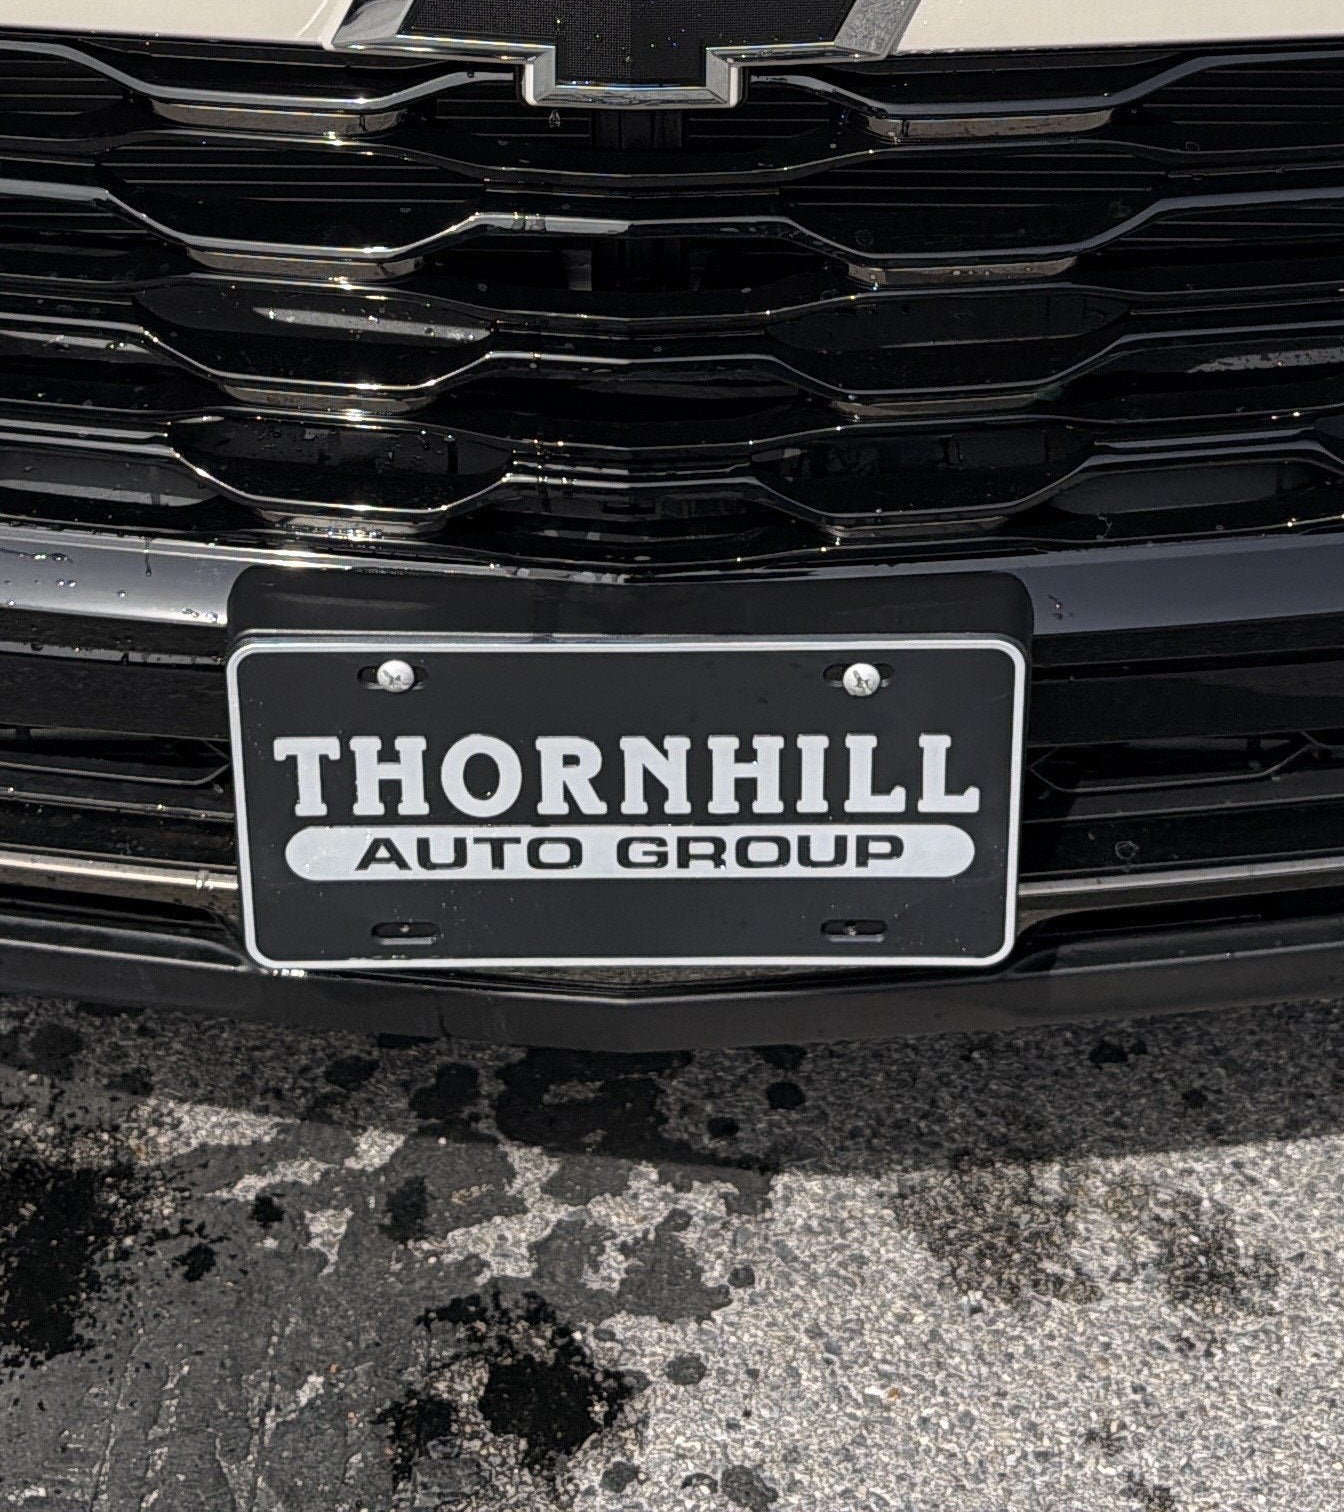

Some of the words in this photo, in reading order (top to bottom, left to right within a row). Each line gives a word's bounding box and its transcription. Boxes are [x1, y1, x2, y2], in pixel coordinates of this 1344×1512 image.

[272, 732, 982, 819] THORNHILL
[354, 834, 584, 872] AUTO
[615, 833, 906, 872] GROUP
